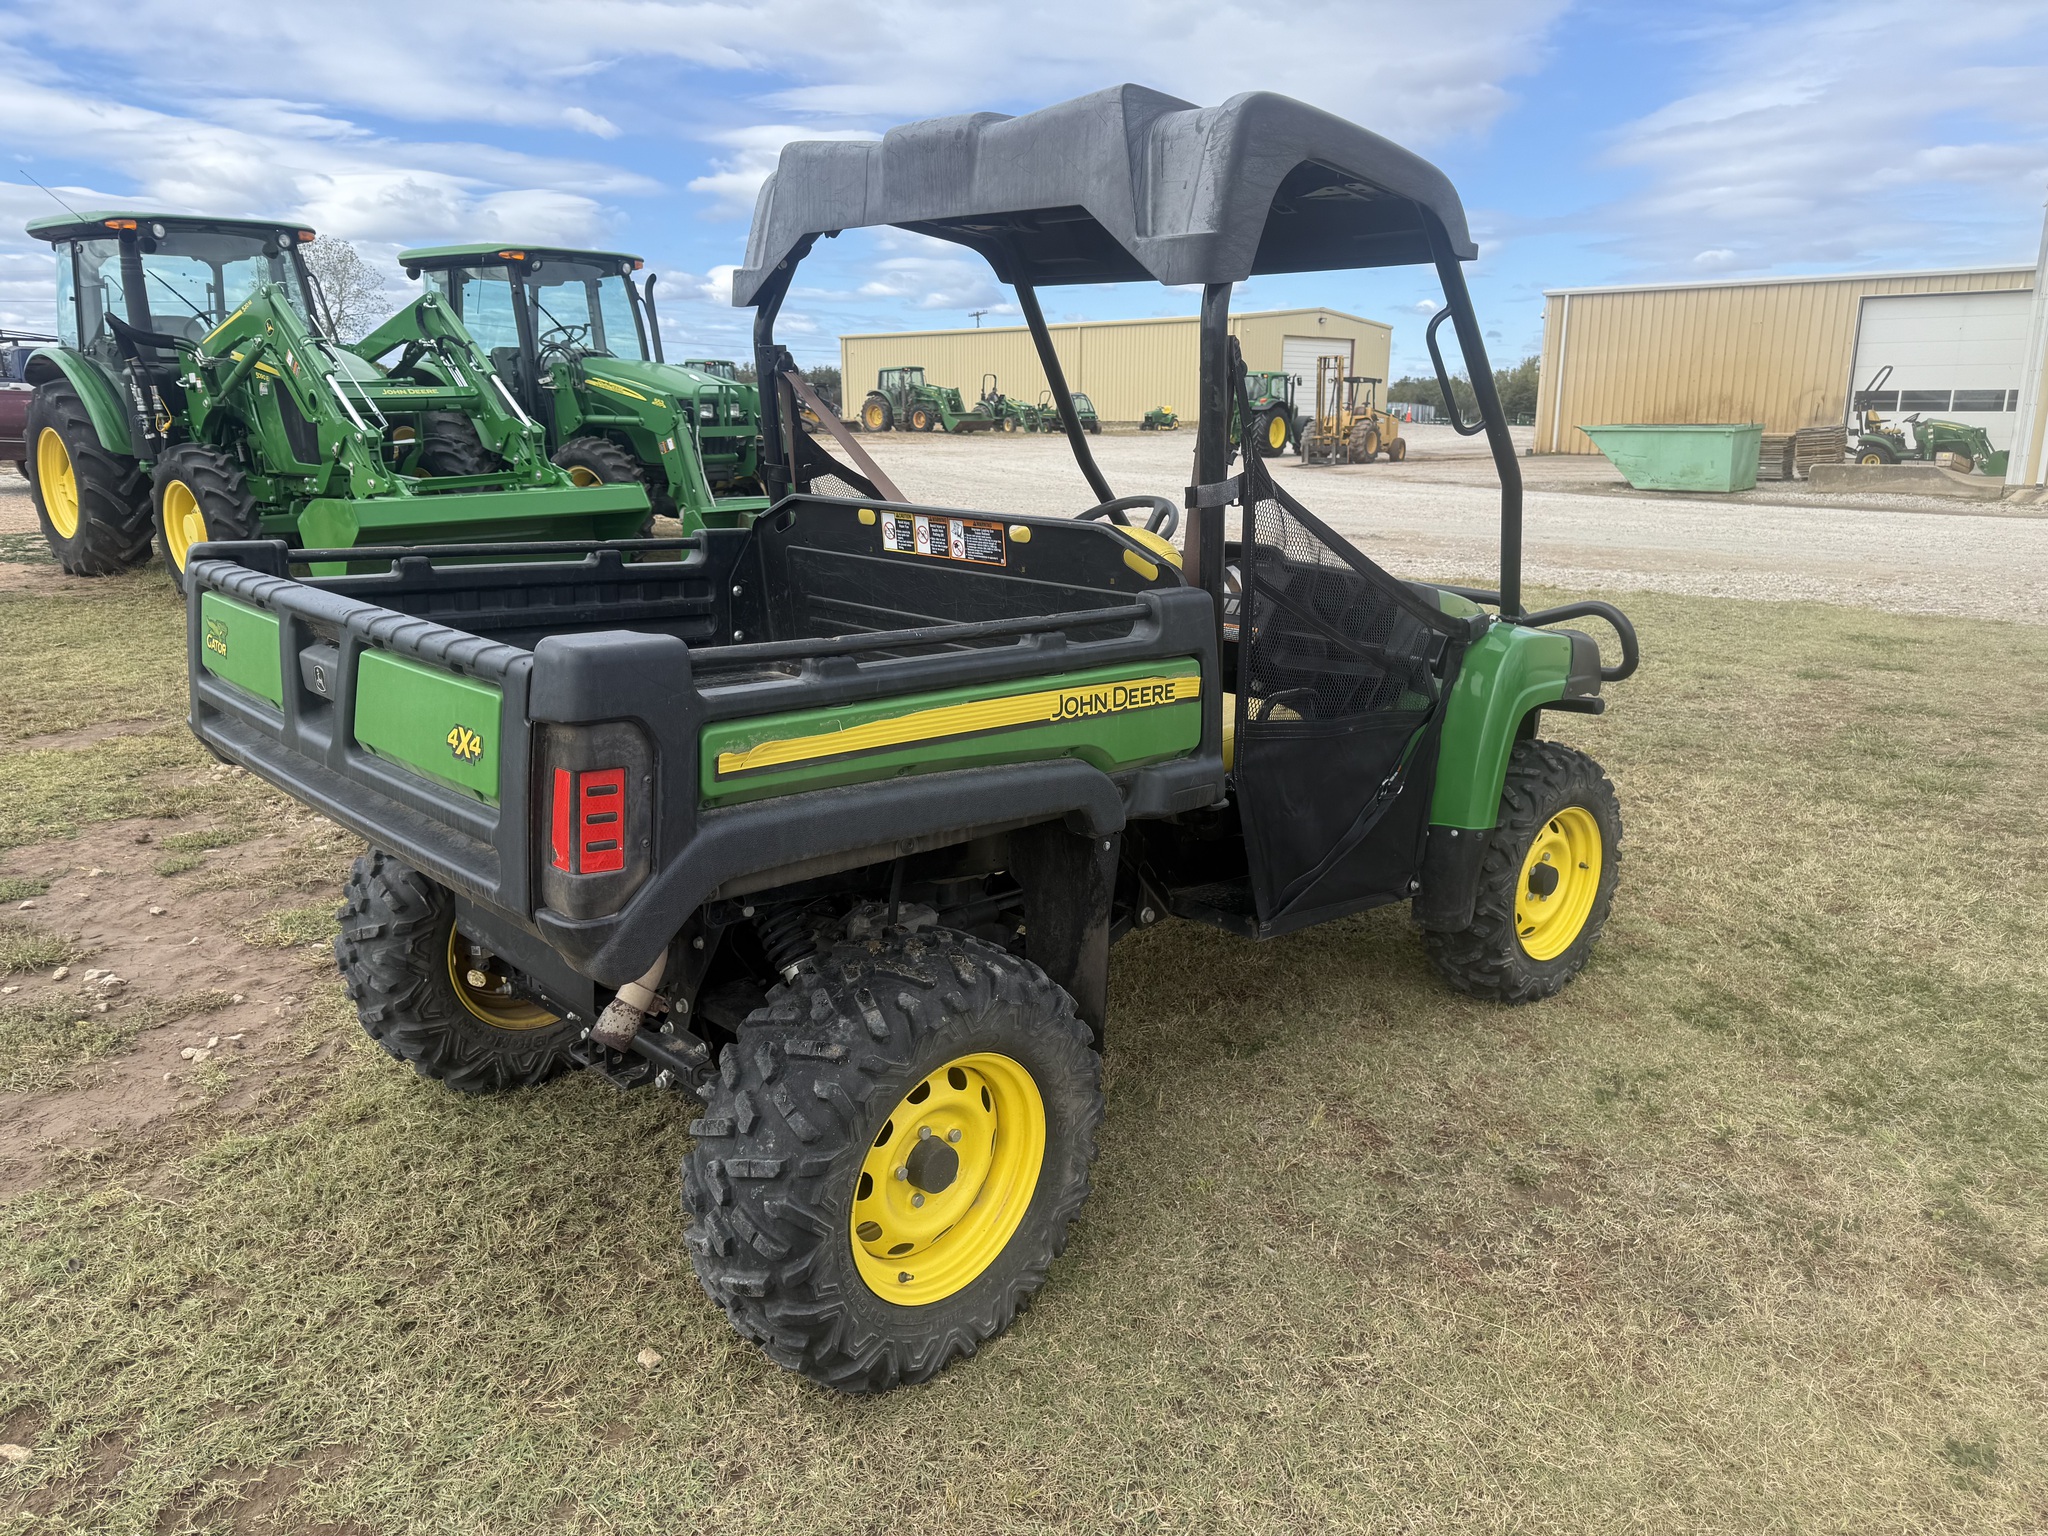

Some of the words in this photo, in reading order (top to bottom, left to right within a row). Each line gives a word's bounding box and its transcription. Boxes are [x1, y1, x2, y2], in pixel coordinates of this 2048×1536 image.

[206, 633, 227, 657] GATOR
[1052, 692, 1108, 719] JOHN
[1112, 682, 1176, 708] DEERE
[835, 1229, 889, 1328] BIGHORN
